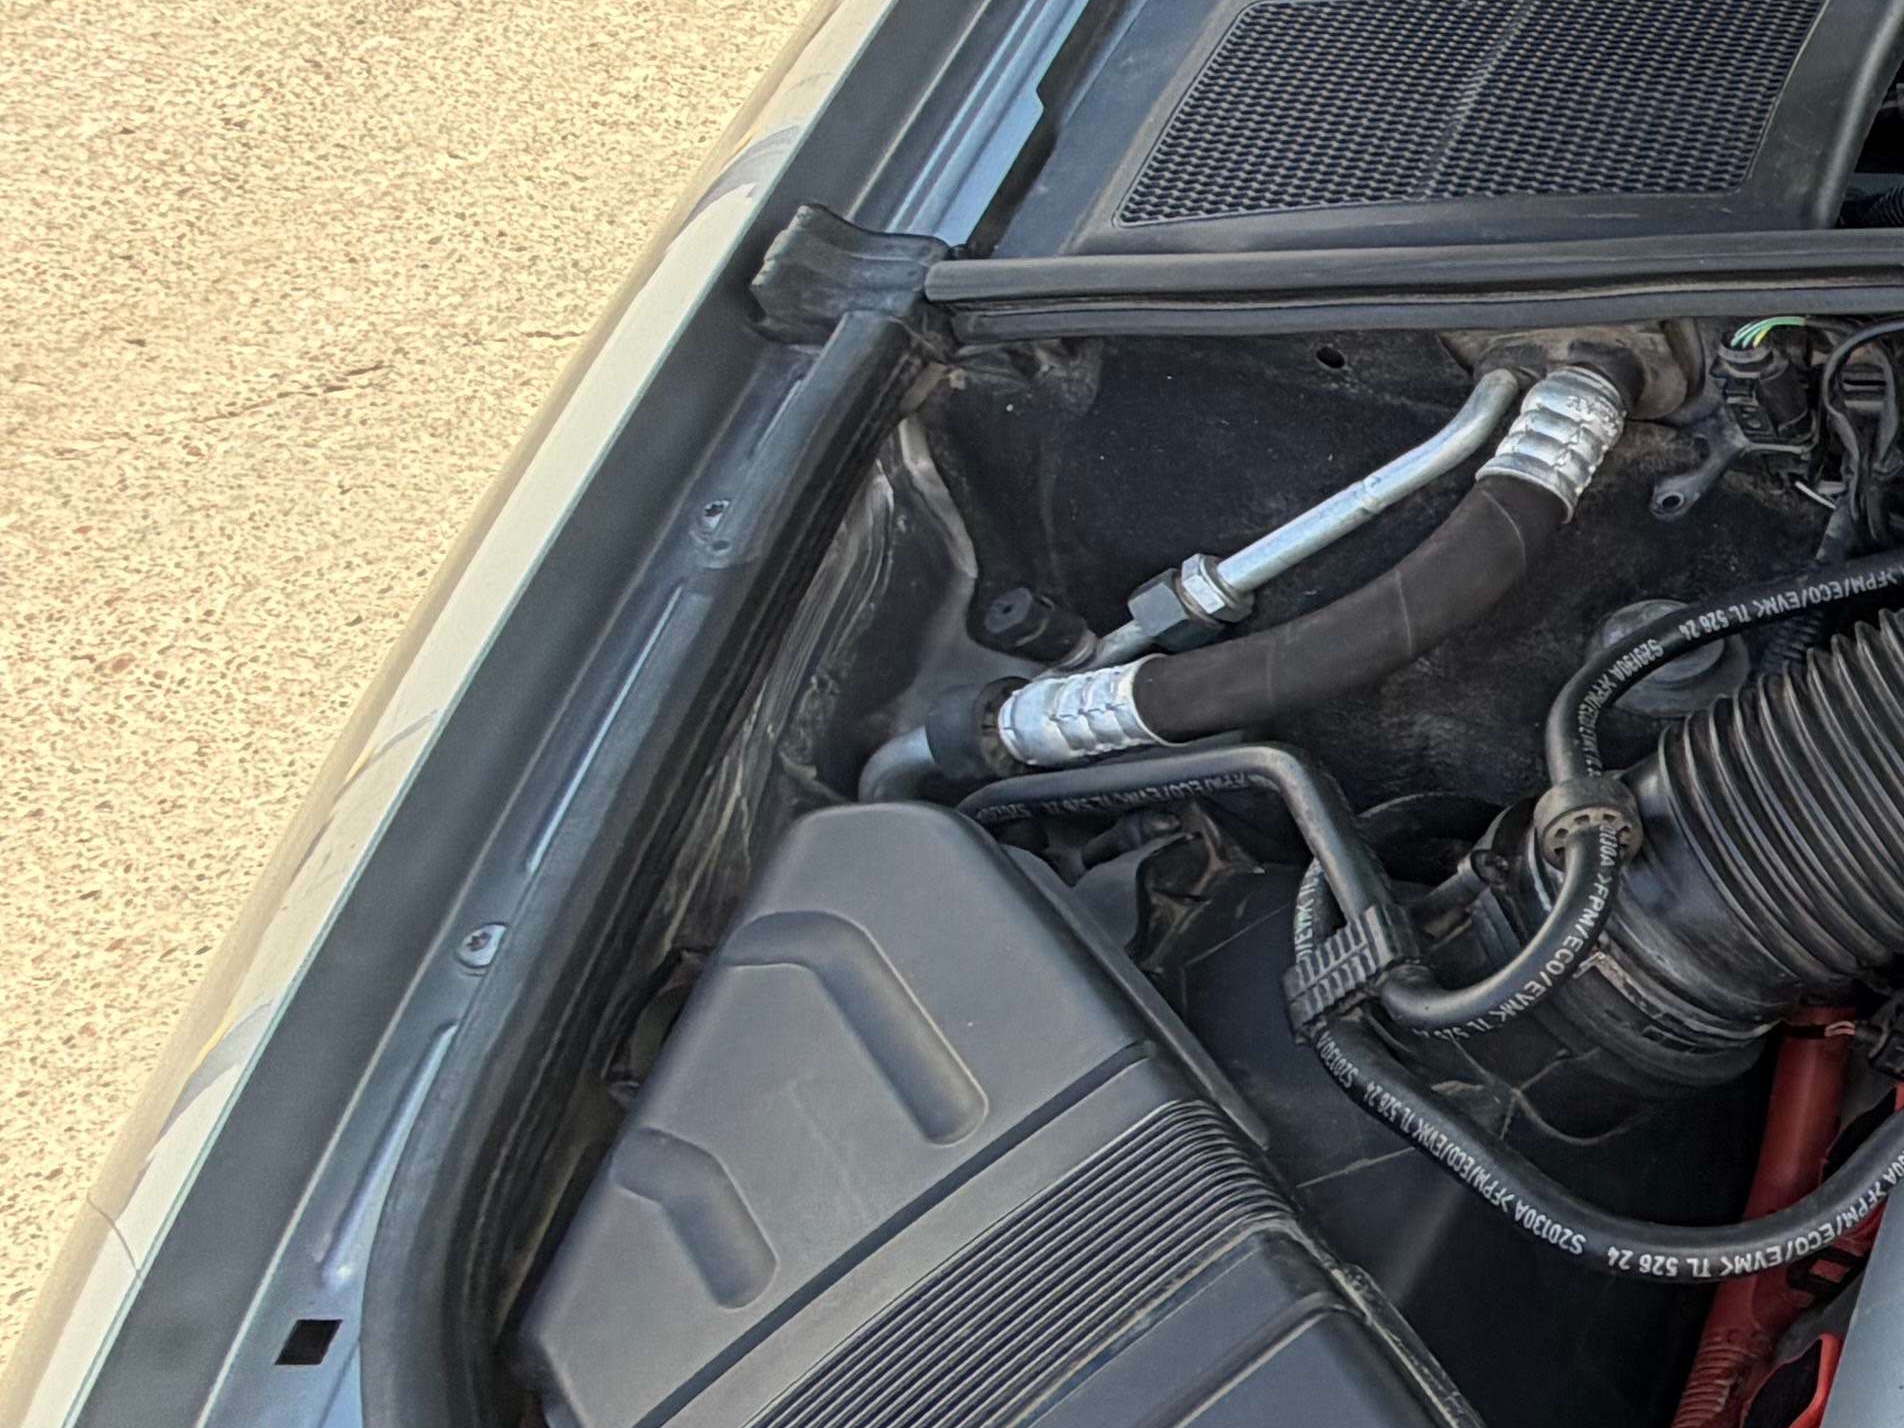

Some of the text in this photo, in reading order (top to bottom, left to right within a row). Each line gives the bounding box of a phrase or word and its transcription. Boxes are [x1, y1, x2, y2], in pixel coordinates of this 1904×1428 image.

[1606, 1246, 1634, 1272] 24
[1638, 1253, 1678, 1277] 526
[1686, 1256, 1713, 1278] TL
